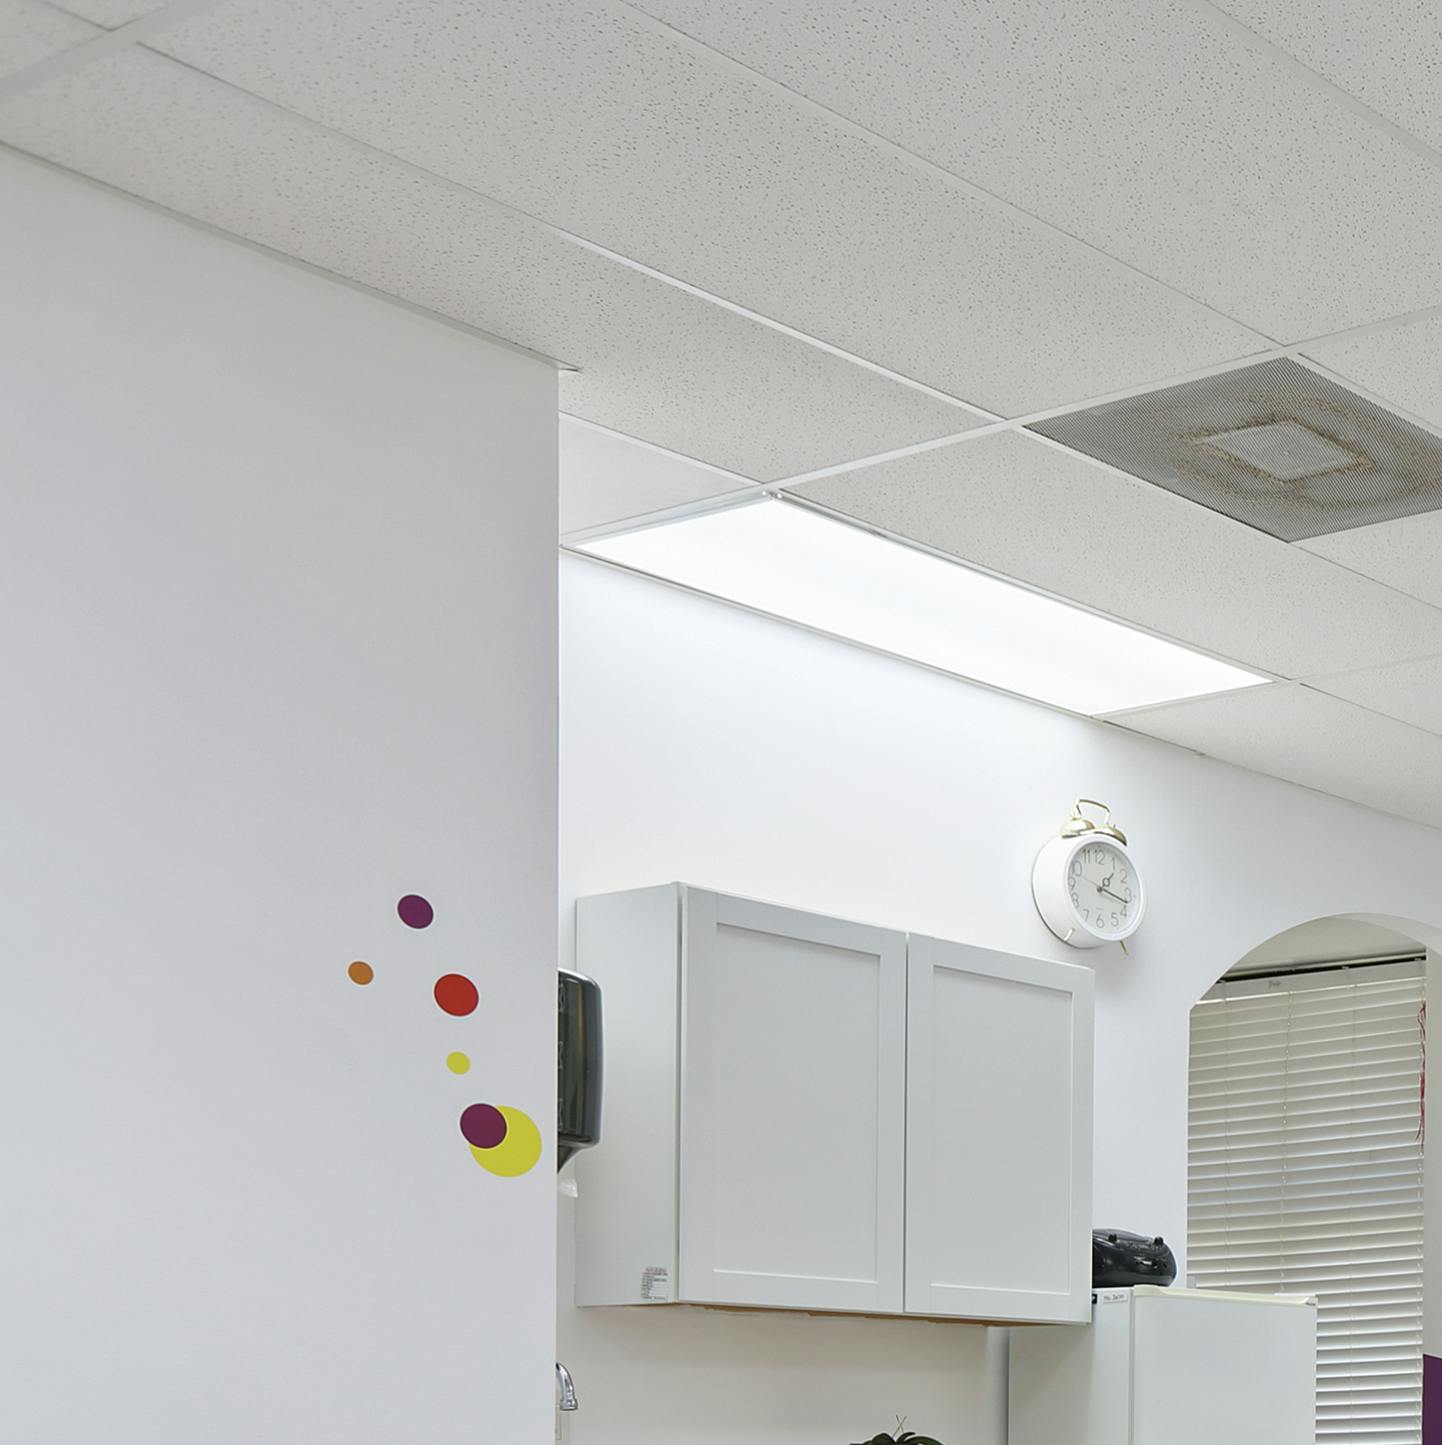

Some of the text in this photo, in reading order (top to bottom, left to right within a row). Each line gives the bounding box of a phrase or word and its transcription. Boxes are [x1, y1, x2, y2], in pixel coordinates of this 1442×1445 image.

[1082, 848, 1091, 865] 11
[1094, 849, 1105, 865] 12
[1068, 876, 1076, 891] 9
[1120, 869, 1127, 884] 2
[1072, 893, 1079, 908] 8
[1124, 888, 1131, 903] 3
[1083, 909, 1089, 922] 7
[1120, 906, 1127, 917] 4
[1096, 914, 1104, 928] 6
[1111, 913, 1118, 926] 5
